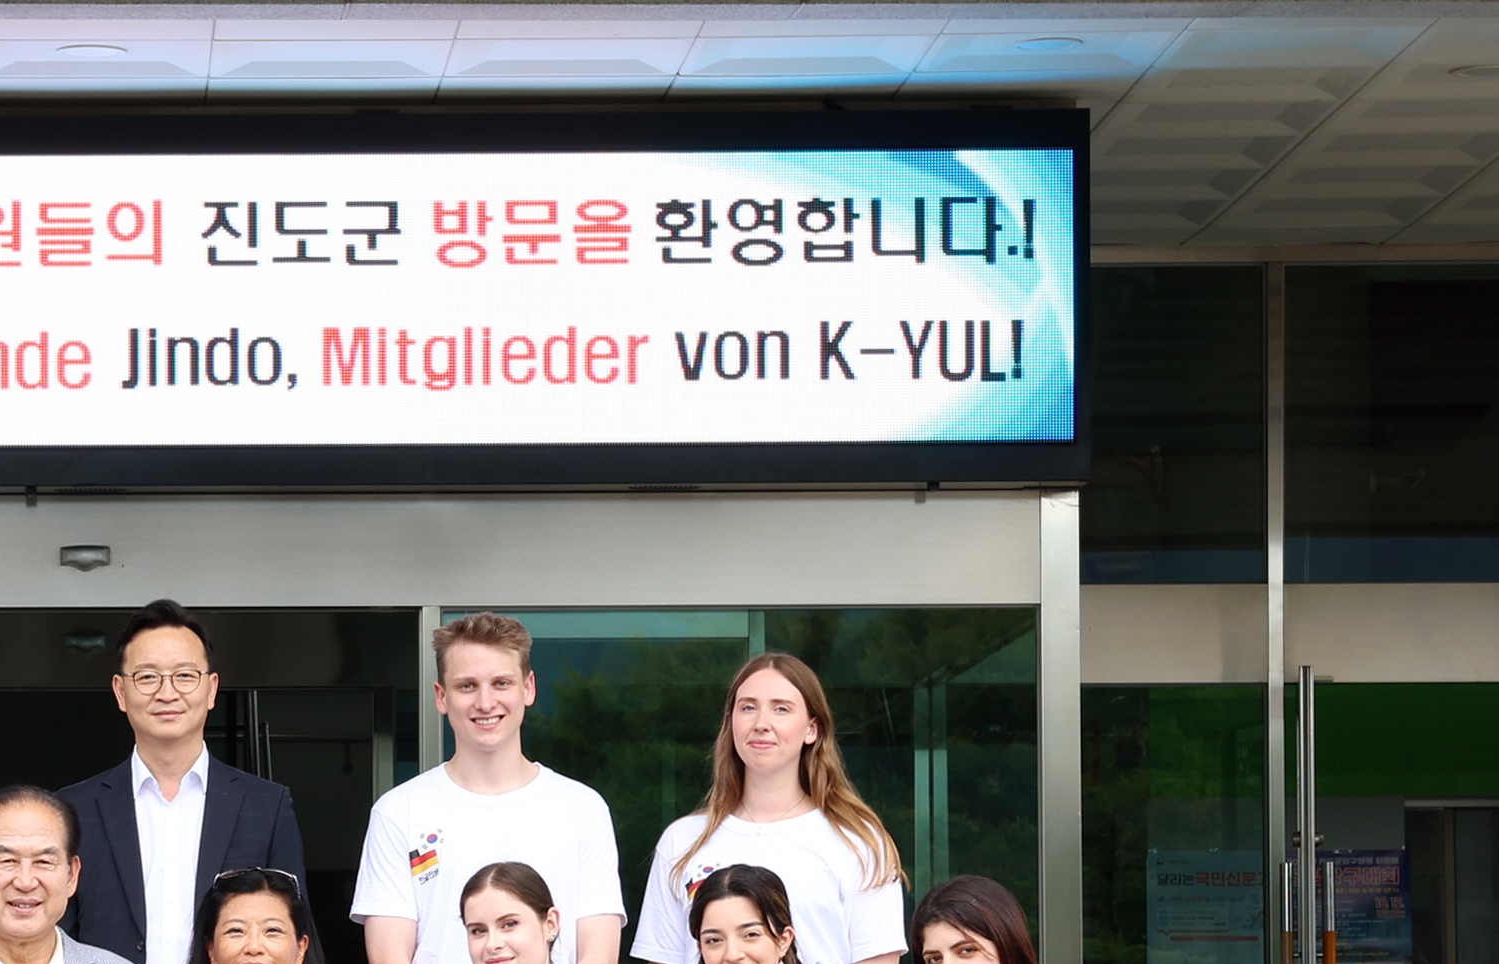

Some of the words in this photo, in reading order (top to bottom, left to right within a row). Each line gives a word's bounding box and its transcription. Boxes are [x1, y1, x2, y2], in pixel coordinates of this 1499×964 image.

[201, 200, 401, 267] 진도군
[433, 199, 631, 268] 방문을
[654, 196, 1035, 267] 환영합니다.!
[121, 327, 298, 390] Jindo,
[322, 326, 648, 391] Mitglieder
[674, 330, 790, 382] von
[819, 319, 1024, 382] K-YUL!
